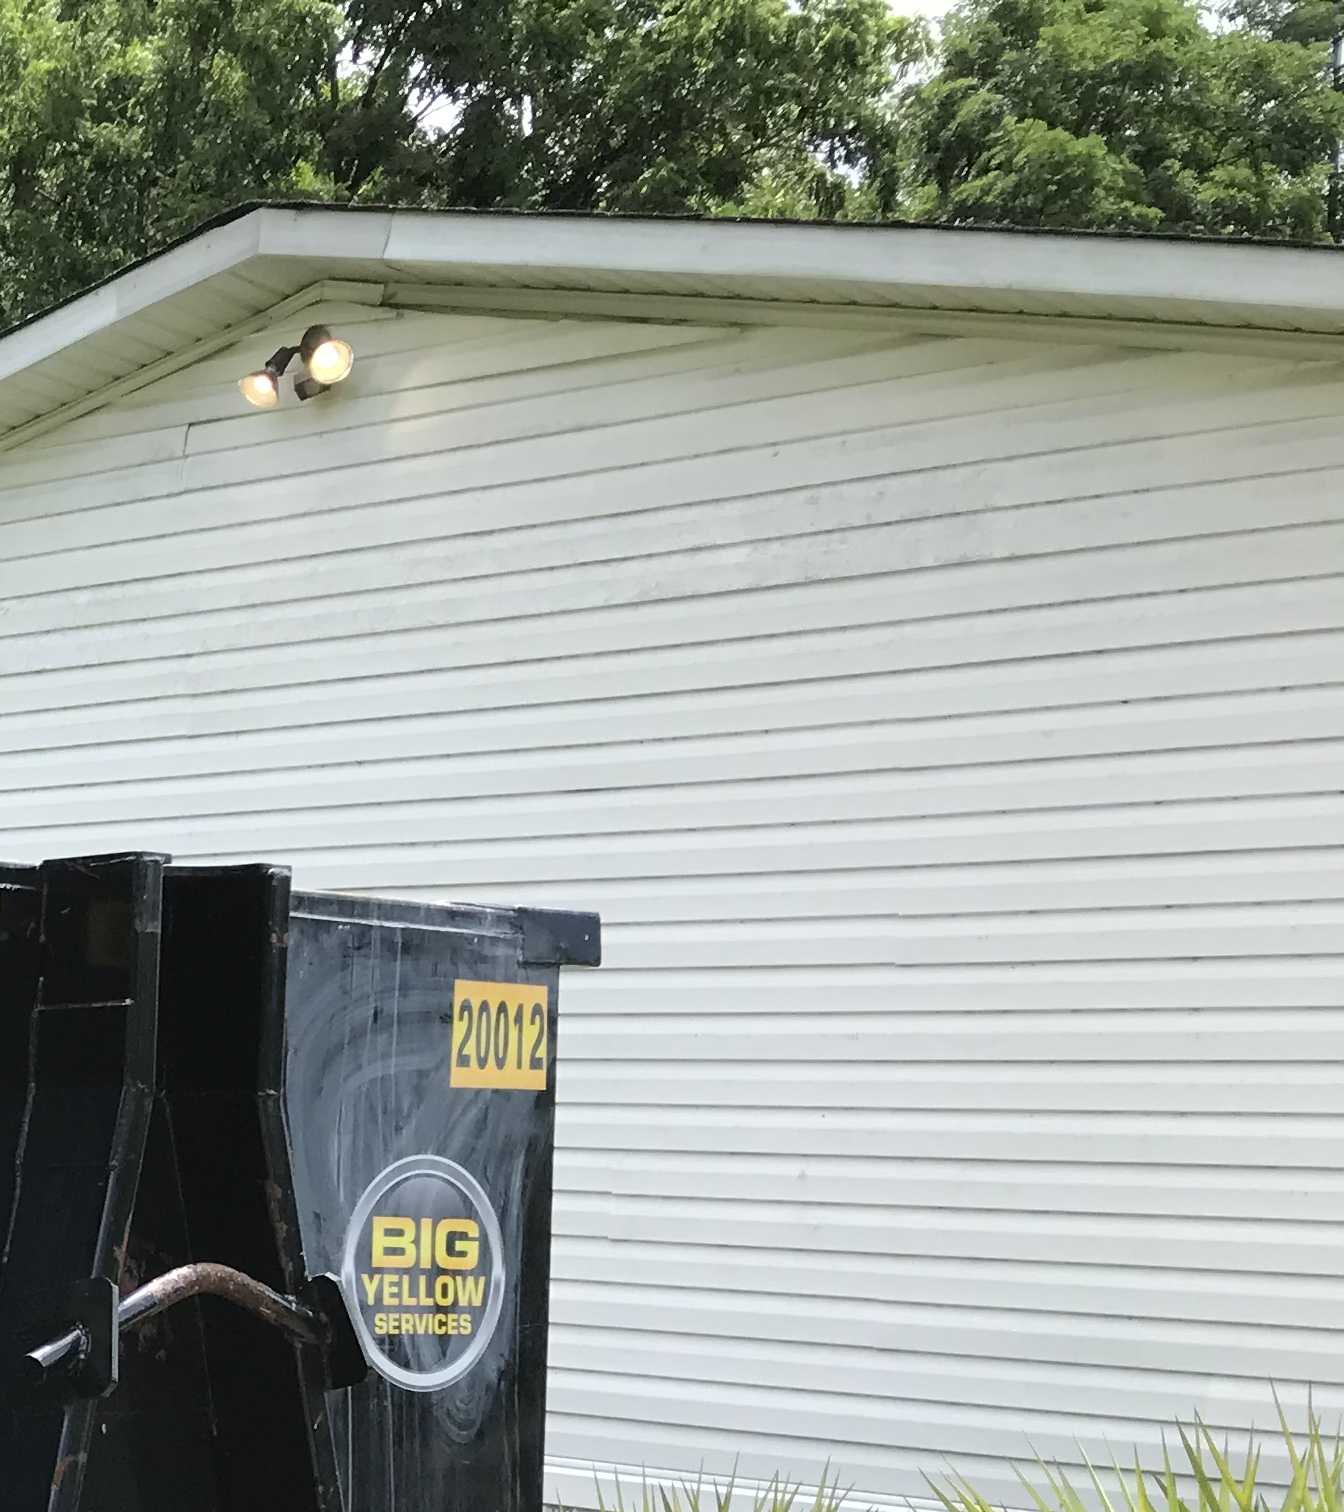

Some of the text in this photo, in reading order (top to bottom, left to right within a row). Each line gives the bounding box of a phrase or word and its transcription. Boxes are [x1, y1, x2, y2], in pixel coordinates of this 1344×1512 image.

[456, 998, 545, 1071] 20012
[371, 1216, 480, 1271] BIG
[361, 1273, 486, 1308] YELLOW
[374, 1312, 473, 1336] SERVICES
